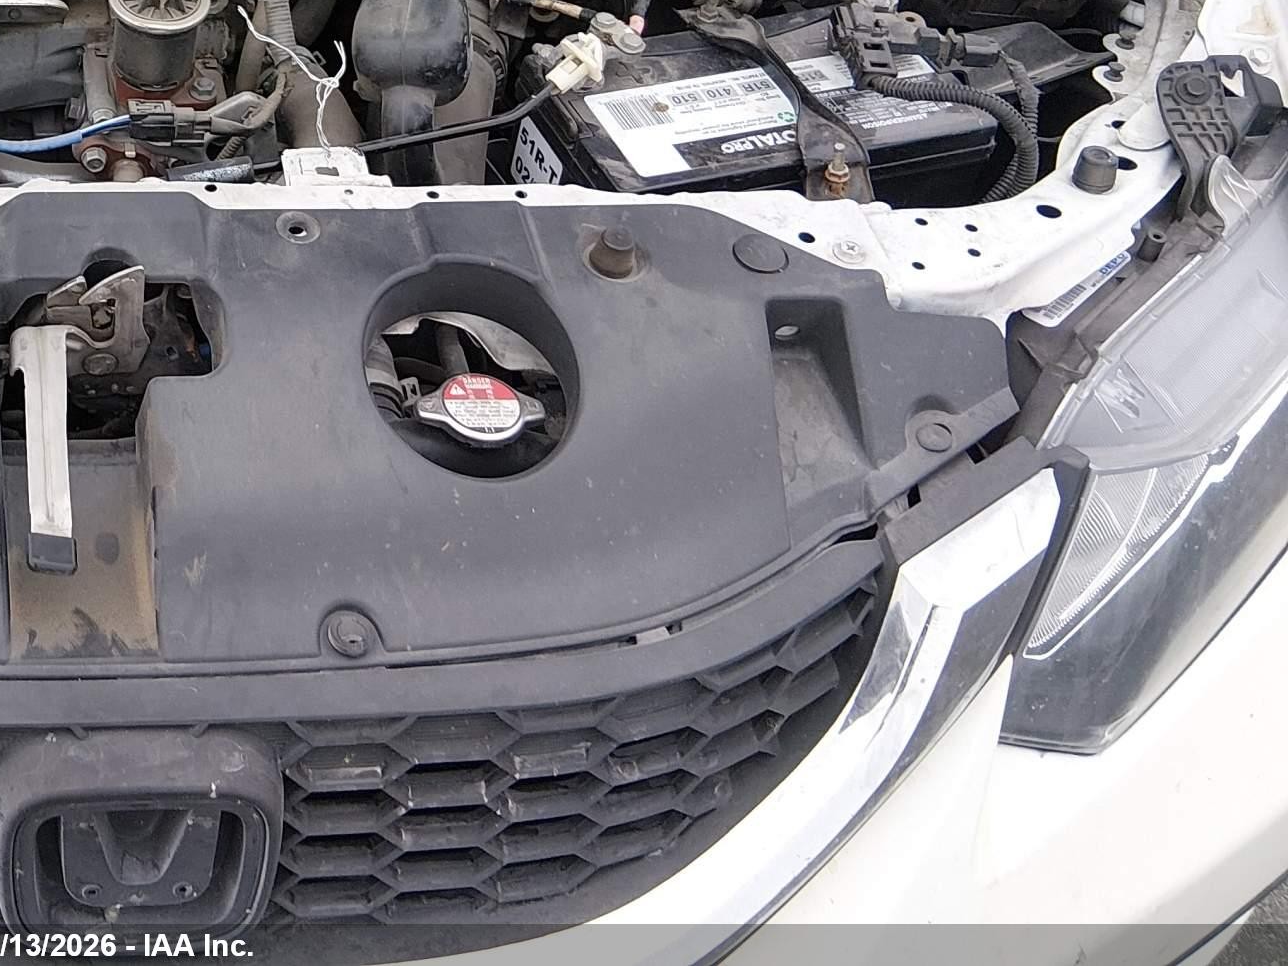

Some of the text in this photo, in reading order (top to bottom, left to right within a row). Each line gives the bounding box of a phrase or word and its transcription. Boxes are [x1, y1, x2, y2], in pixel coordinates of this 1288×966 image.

[706, 86, 731, 98] 410
[741, 80, 770, 92] 51R
[671, 93, 698, 104] 510
[720, 129, 797, 154] OTALPRO
[520, 127, 558, 184] 51R-T
